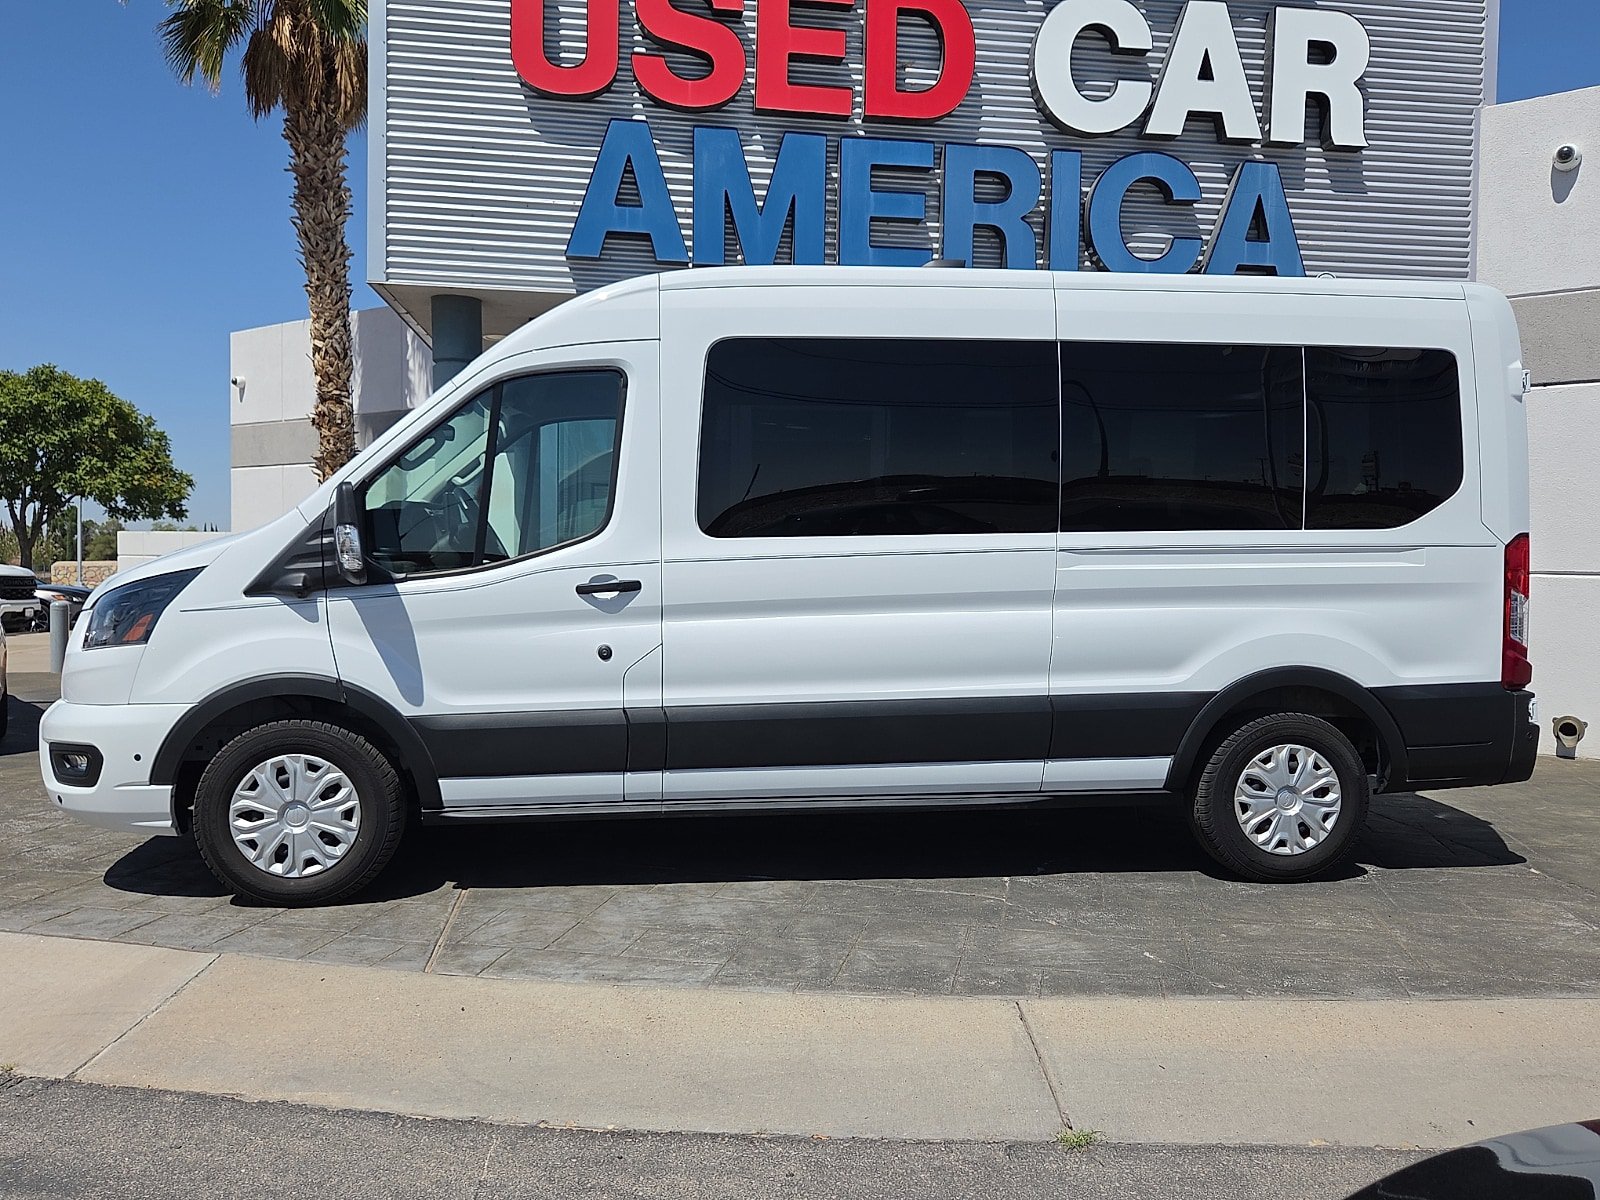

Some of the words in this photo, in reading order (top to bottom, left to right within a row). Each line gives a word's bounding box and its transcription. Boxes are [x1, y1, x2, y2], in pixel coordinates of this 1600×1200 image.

[509, 0, 976, 121] USED
[1032, 0, 1371, 149] CAR
[565, 118, 1307, 276] AMERICA
